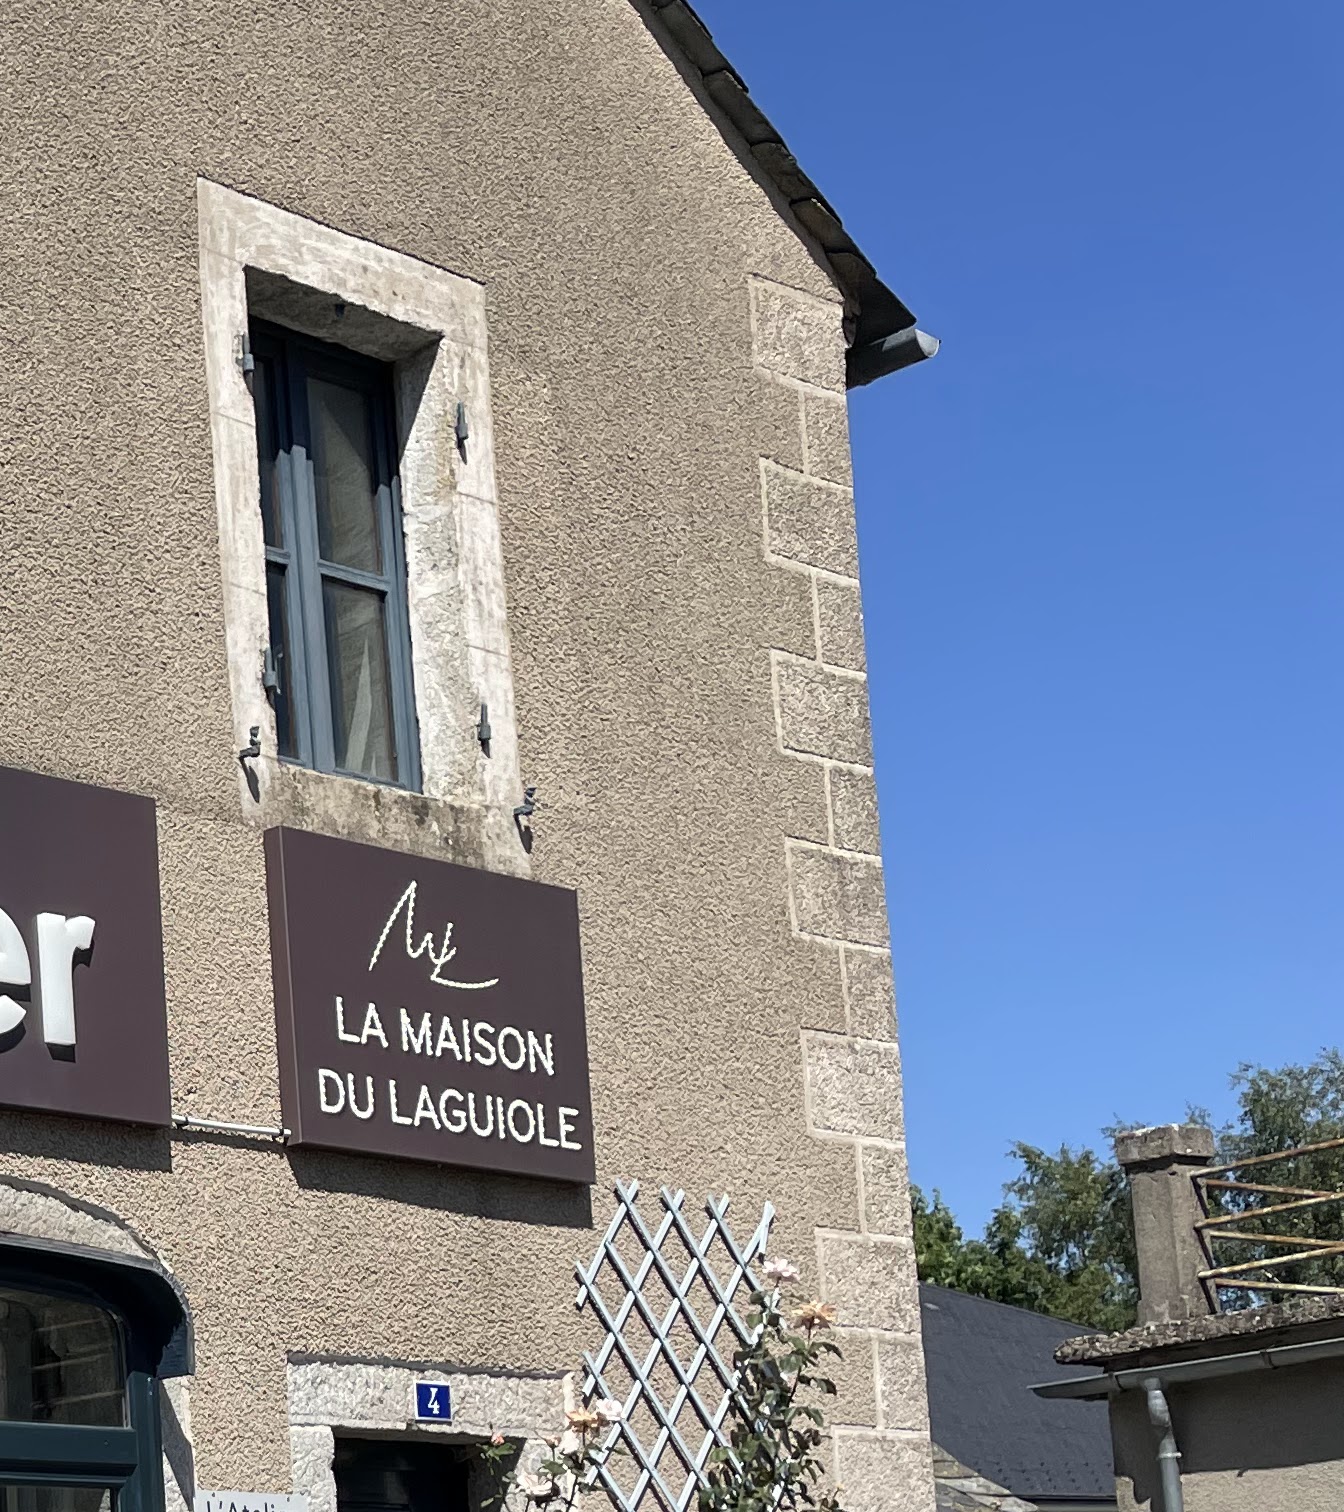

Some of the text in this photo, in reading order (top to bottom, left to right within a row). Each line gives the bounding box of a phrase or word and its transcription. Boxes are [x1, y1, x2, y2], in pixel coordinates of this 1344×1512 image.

[335, 996, 555, 1076] LA MAISON
[318, 1068, 582, 1150] DU LAGUIOLE
[427, 1387, 440, 1414] 4
